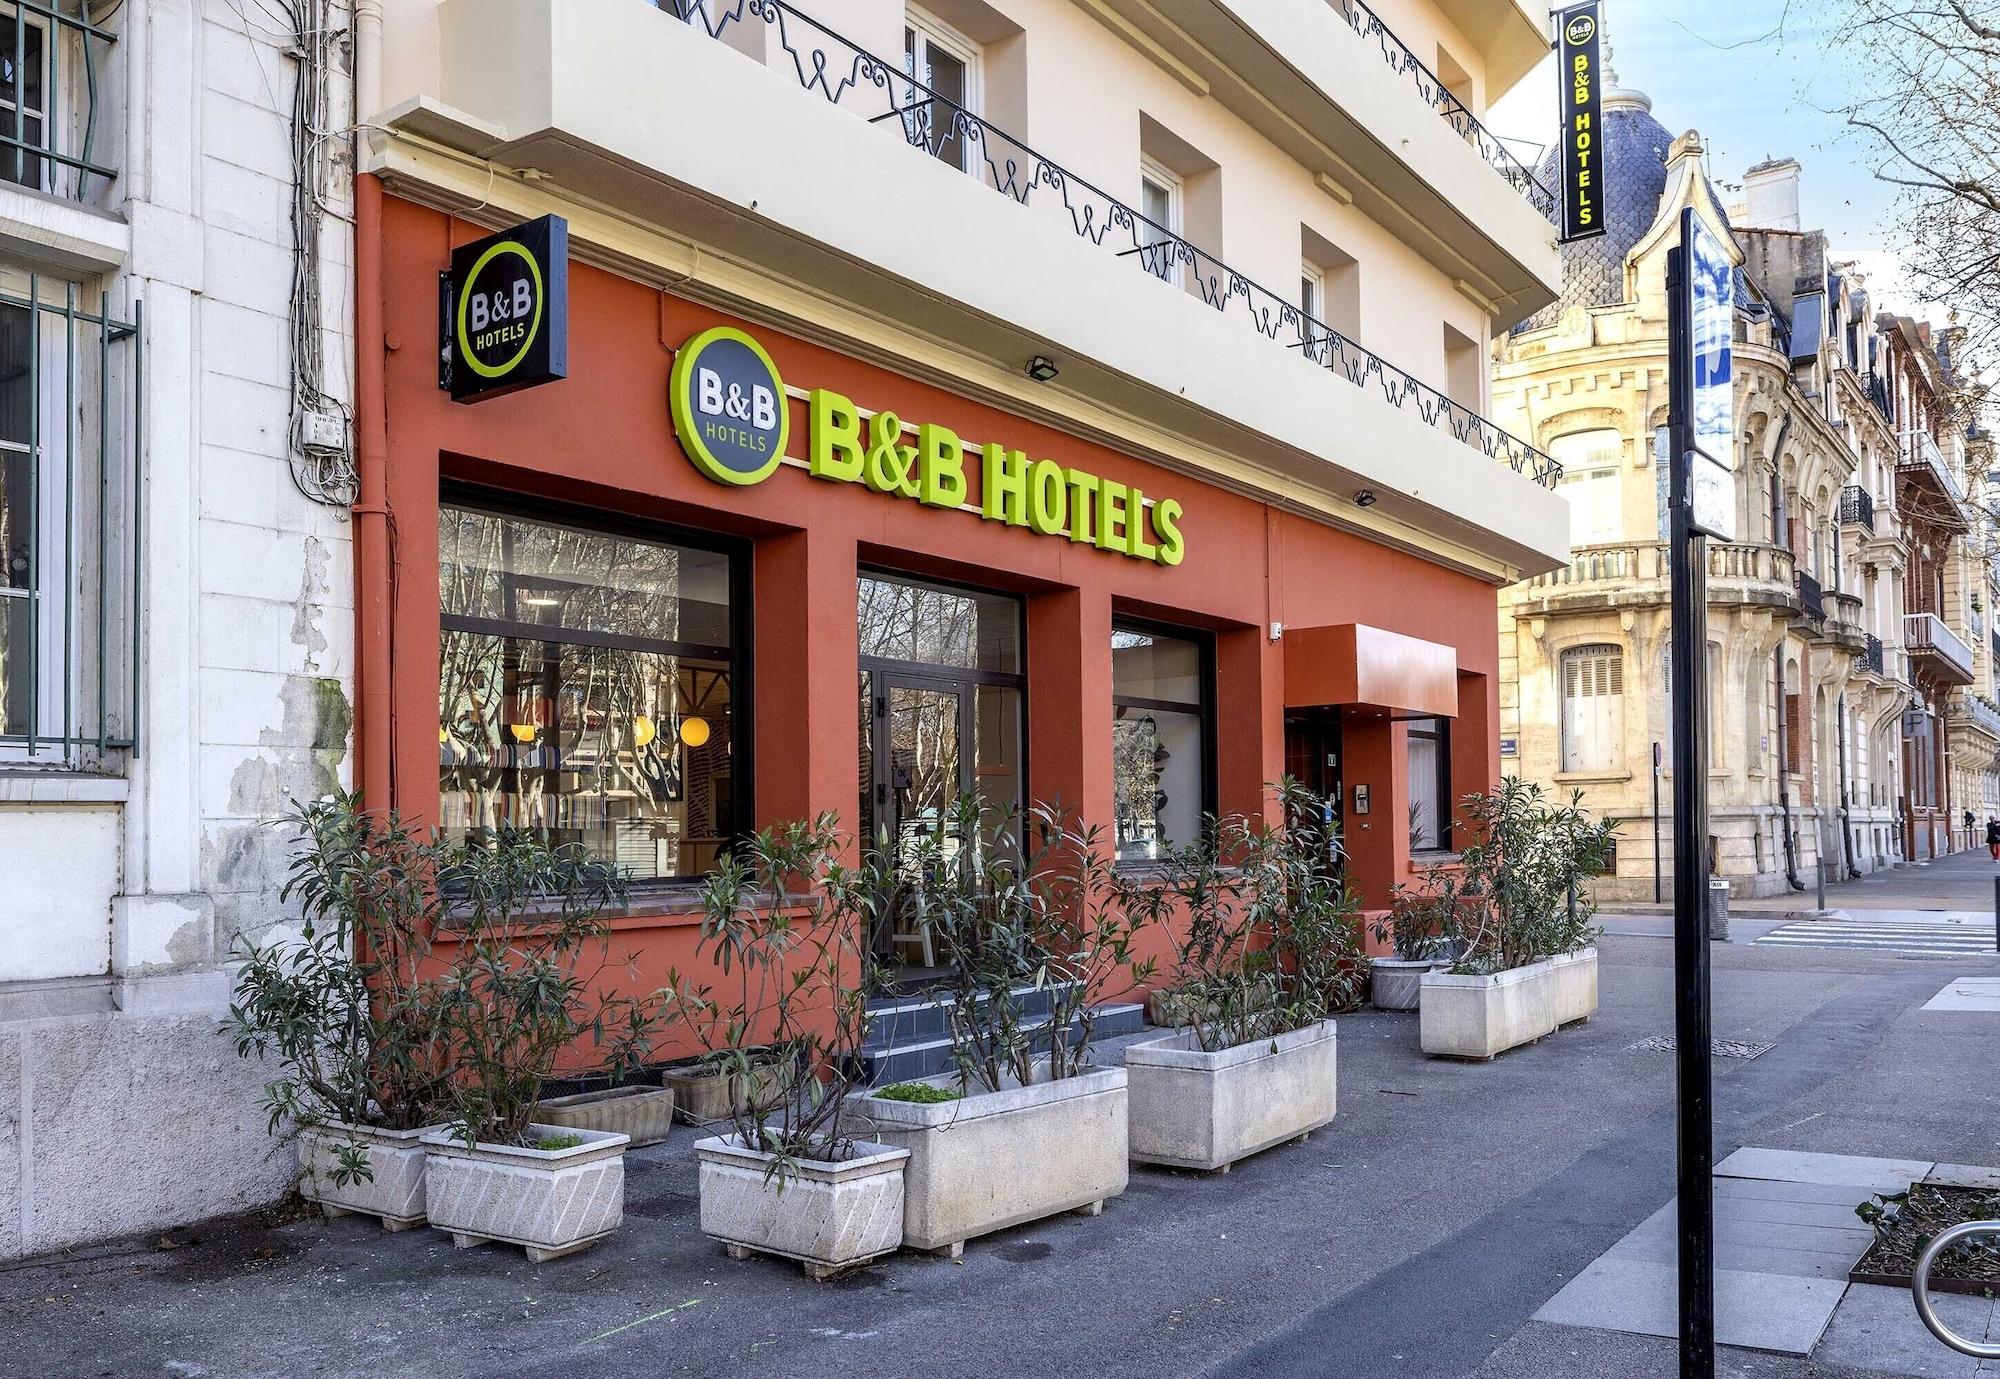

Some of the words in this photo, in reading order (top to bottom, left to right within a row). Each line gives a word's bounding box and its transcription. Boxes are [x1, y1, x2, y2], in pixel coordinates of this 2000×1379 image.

[1570, 22, 1591, 36] B&B
[1574, 54, 1590, 105] B&B
[1576, 114, 1592, 225] HOTELS
[472, 278, 531, 332] B&B
[477, 322, 524, 351] HOTELS
[698, 367, 776, 431] B&B
[706, 421, 766, 452] HOTELS
[809, 388, 968, 509] B&B
[982, 442, 1185, 567] HOTELS
